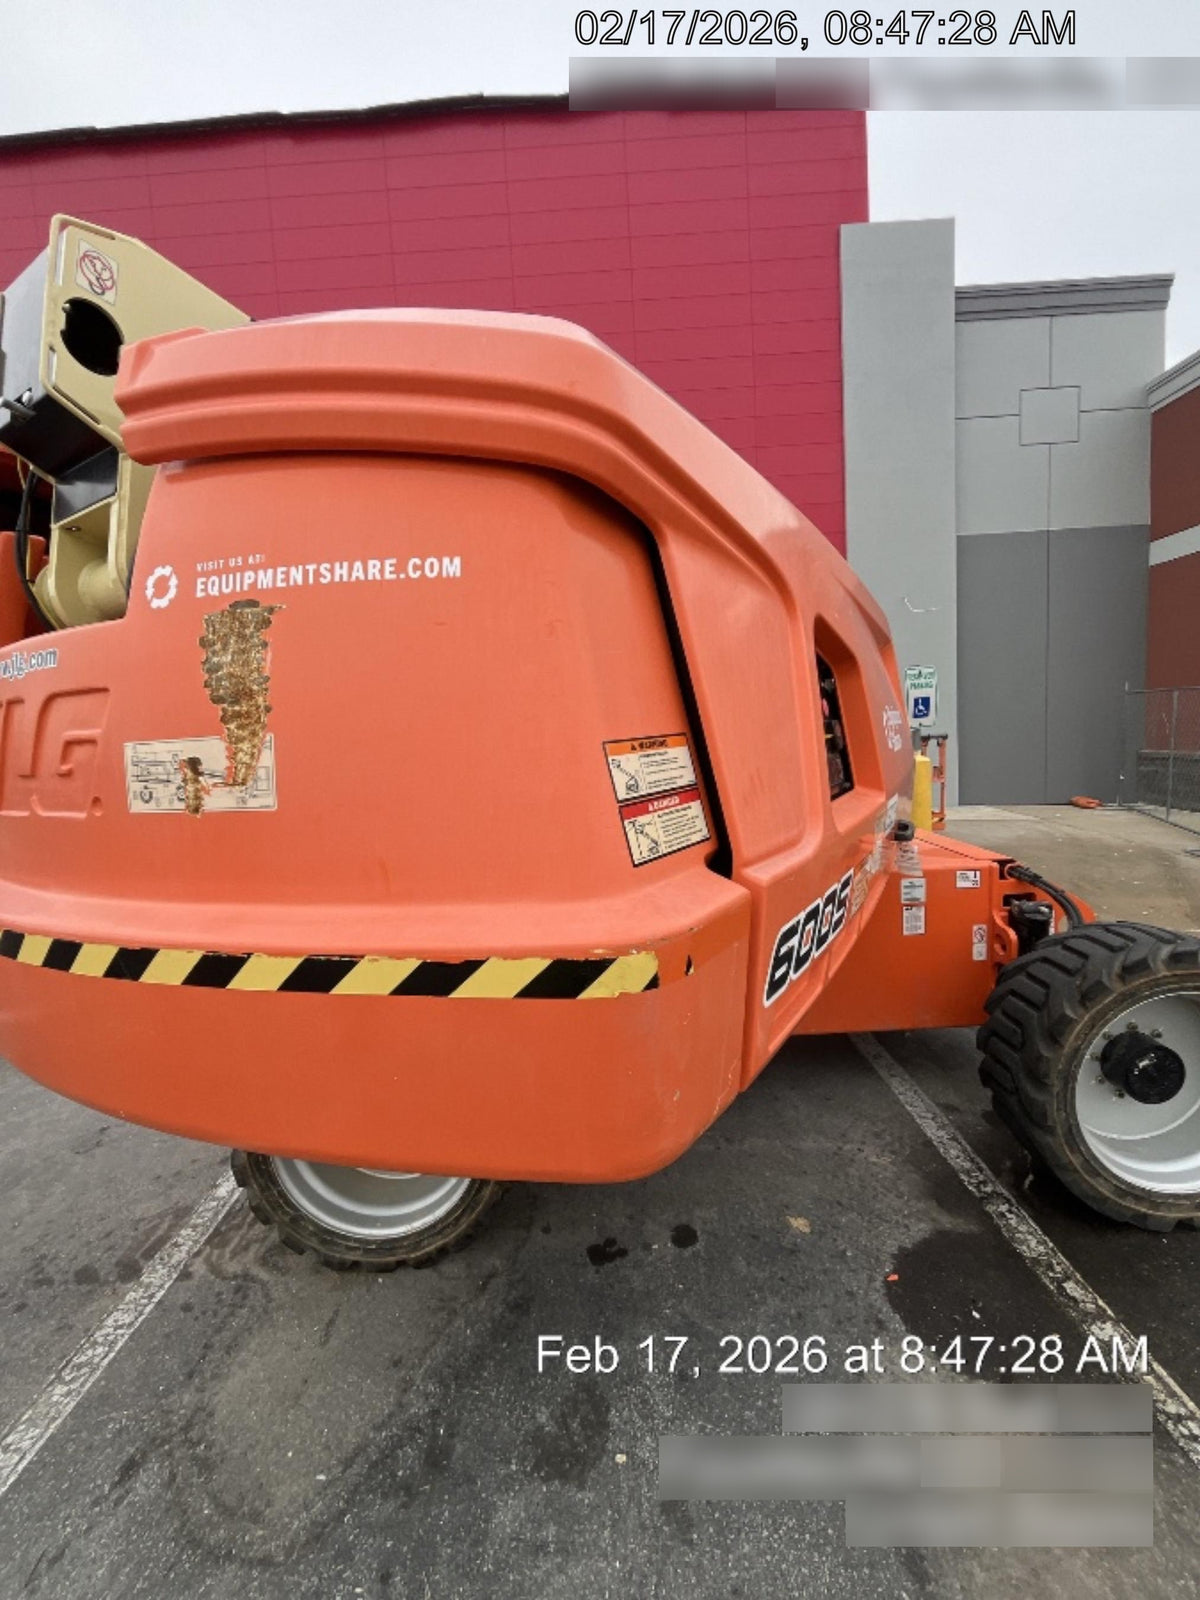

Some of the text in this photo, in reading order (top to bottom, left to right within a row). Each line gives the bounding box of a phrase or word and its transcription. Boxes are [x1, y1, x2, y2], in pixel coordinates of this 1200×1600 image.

[195, 556, 462, 598] EQUIPMENTSHARE.COM
[196, 560, 224, 572] VISIT
[229, 556, 242, 567] US
[764, 867, 854, 1007] 600S
